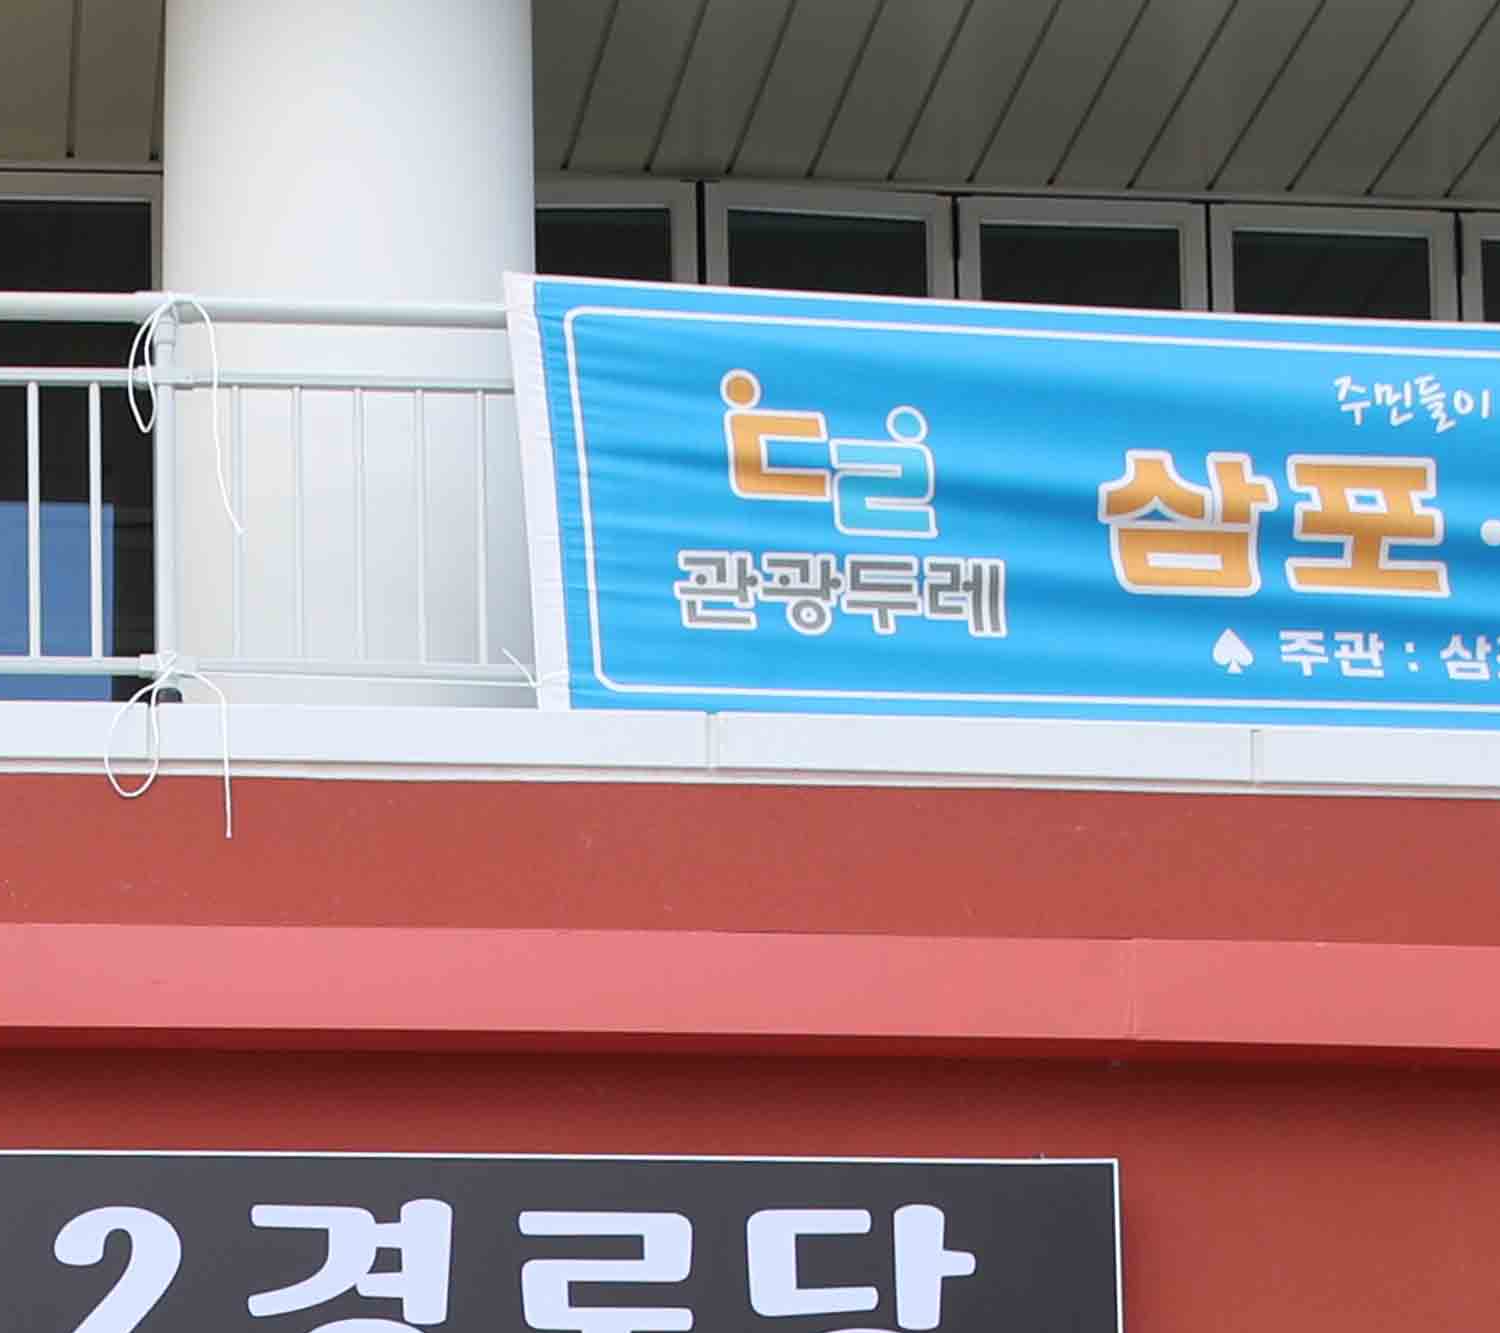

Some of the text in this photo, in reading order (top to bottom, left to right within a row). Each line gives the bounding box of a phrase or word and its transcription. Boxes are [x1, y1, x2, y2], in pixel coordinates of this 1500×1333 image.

[1333, 375, 1491, 433] 주민들이
[673, 549, 1008, 638] 관광두레
[1277, 628, 1385, 678] 주관
